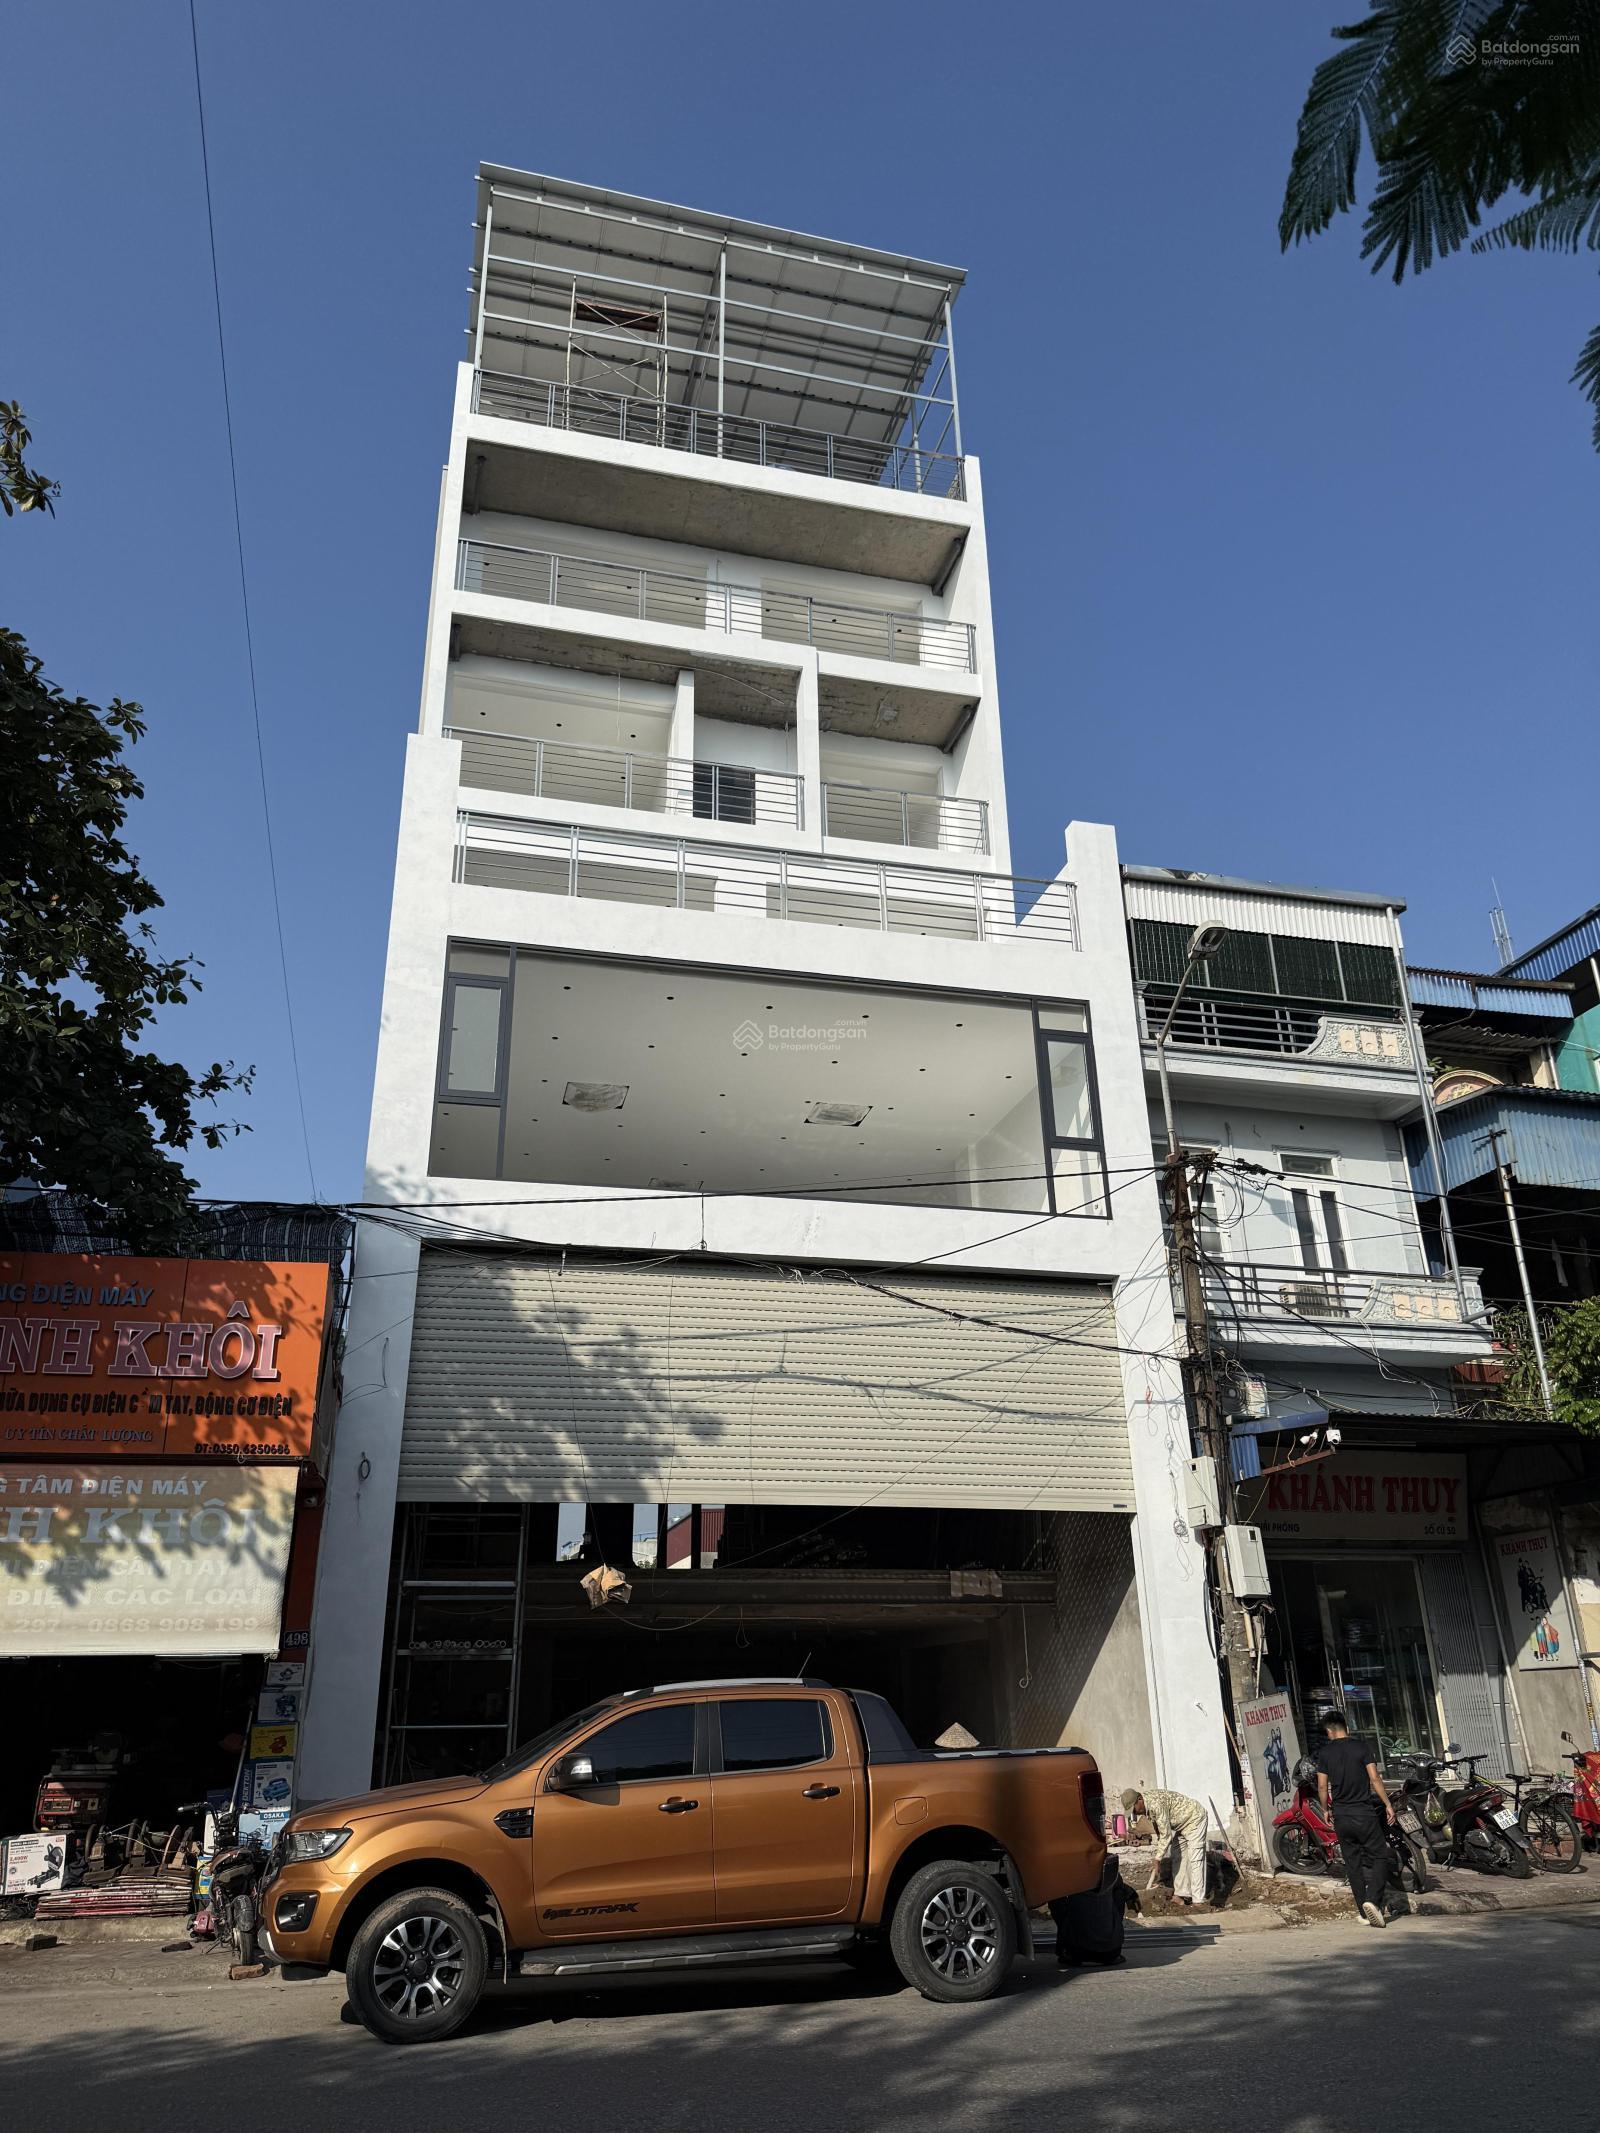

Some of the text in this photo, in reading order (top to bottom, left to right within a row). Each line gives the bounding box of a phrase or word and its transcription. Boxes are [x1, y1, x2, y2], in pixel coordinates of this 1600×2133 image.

[32, 1280, 92, 1310] ĐIỆN
[98, 1279, 154, 1306] MÁY
[108, 1300, 282, 1378] KHÔI
[28, 1392, 68, 1415] DỤNG
[71, 1392, 91, 1416] CỤ
[93, 1389, 126, 1416] ĐIỆN
[129, 1387, 162, 1414] CM
[195, 1391, 234, 1419] ĐỘNG
[258, 1392, 293, 1419] ĐIỆN
[30, 1426, 56, 1441] TÍN
[58, 1423, 96, 1441] CHẤT
[101, 1427, 154, 1444] LƯỢNG
[16, 1475, 73, 1494] TÂM
[81, 1475, 144, 1498] ĐIỆN
[152, 1473, 208, 1496] MÁY
[1267, 1463, 1376, 1514] KHÁNH
[80, 1497, 263, 1544] KHÔI
[1500, 1537, 1527, 1556] KHÁNH
[102, 1585, 173, 1606] CÁC
[159, 1617, 206, 1632] 908
[214, 1616, 259, 1632] 199
[1245, 1705, 1269, 1727] KHÁNH
